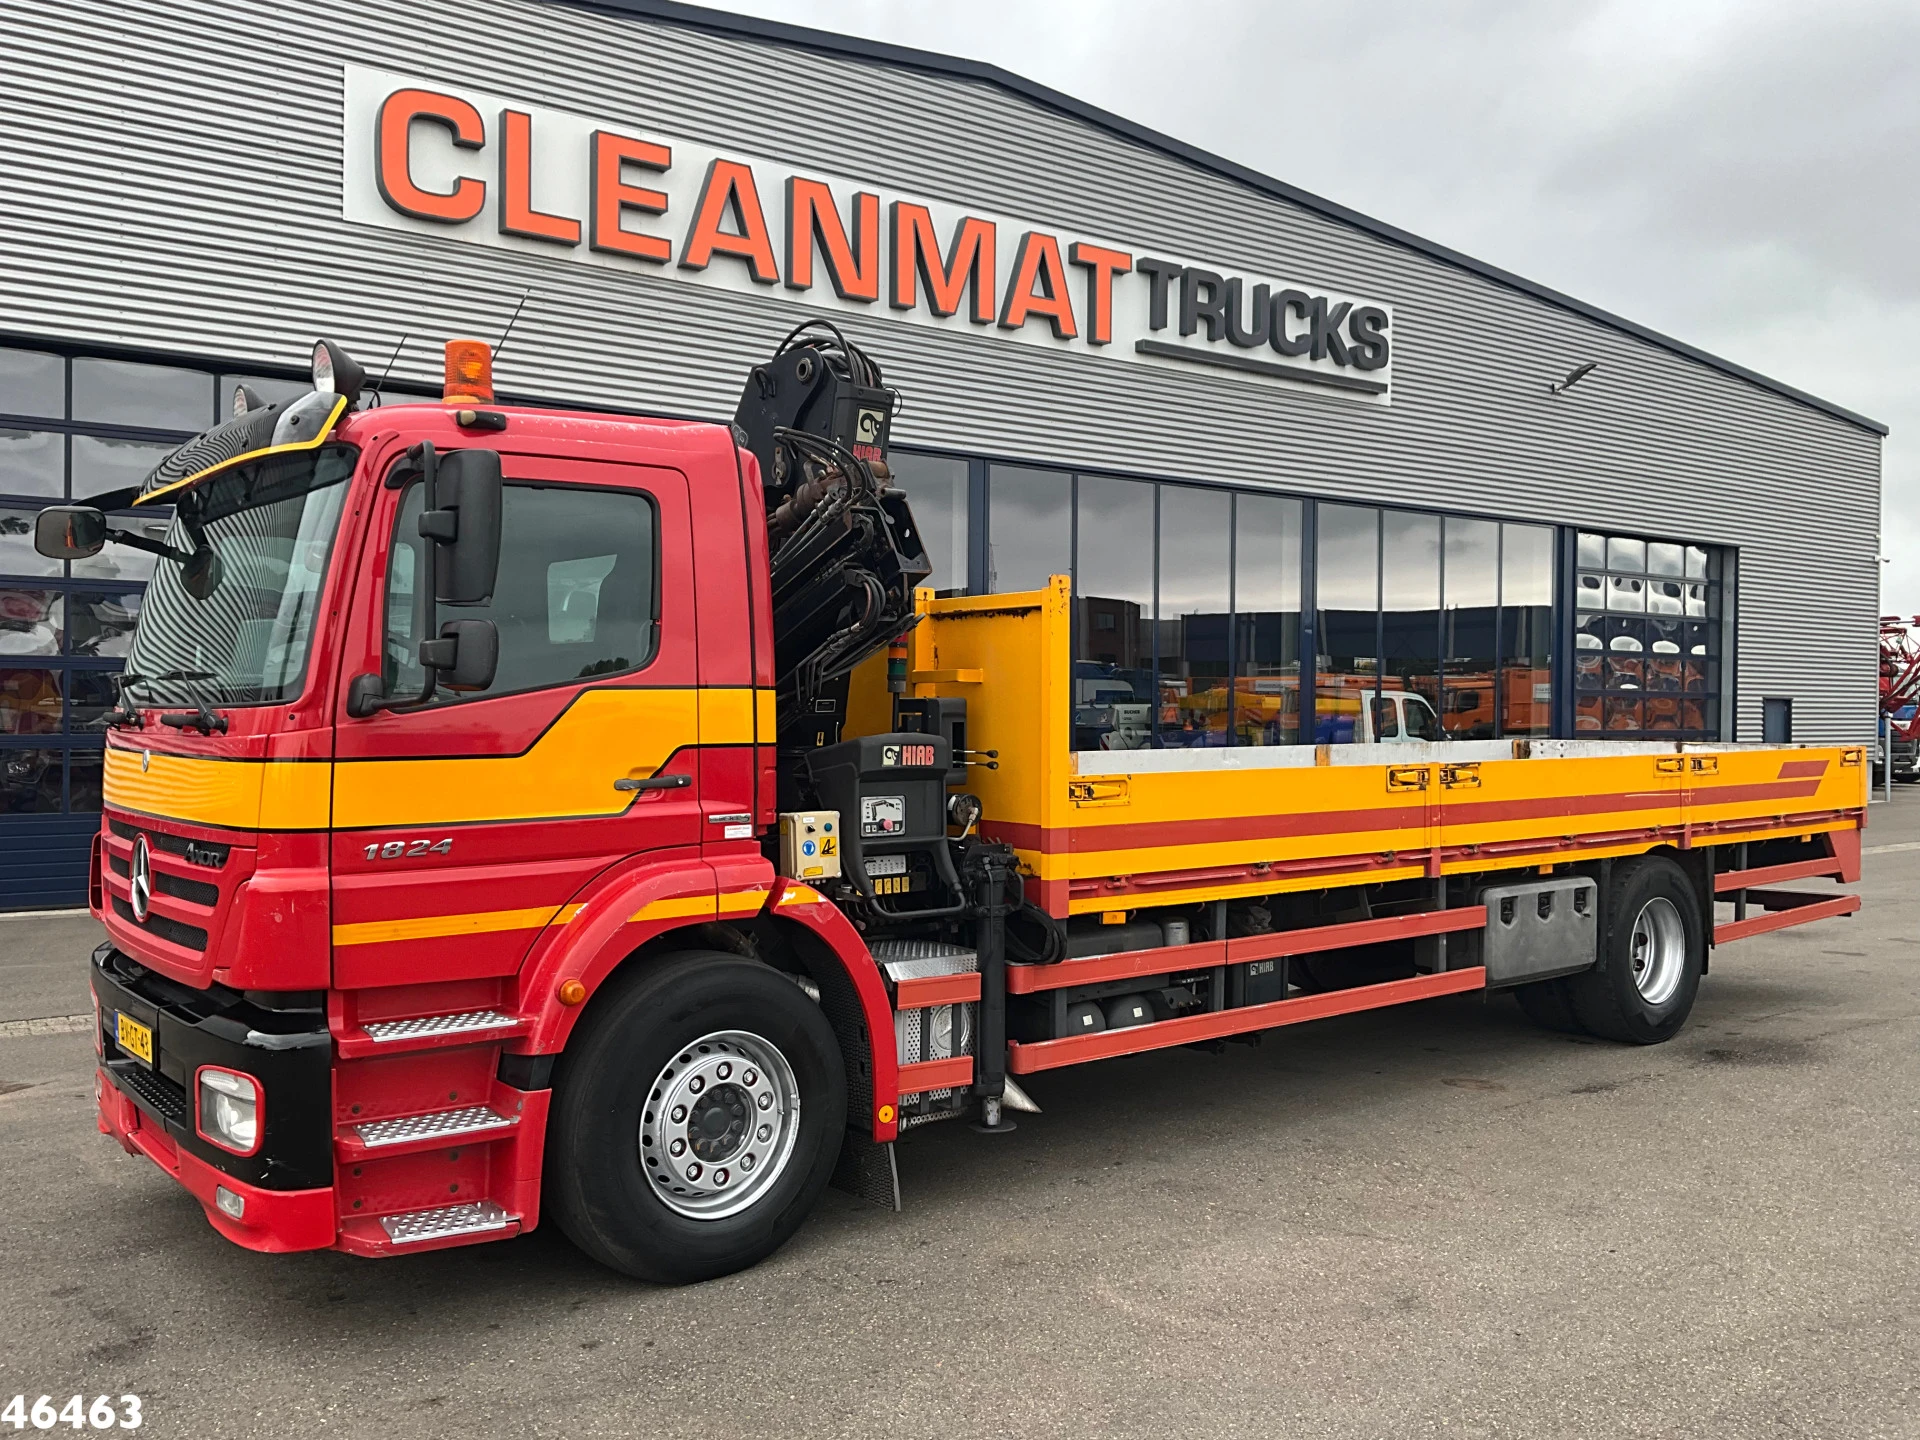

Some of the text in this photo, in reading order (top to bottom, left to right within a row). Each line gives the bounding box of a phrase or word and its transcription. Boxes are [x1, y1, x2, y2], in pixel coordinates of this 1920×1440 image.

[375, 87, 1389, 371] CLEANMAT TRUCKS
[902, 745, 935, 766] HIAB
[364, 838, 453, 861] 1824
[1259, 961, 1274, 974] HIAB
